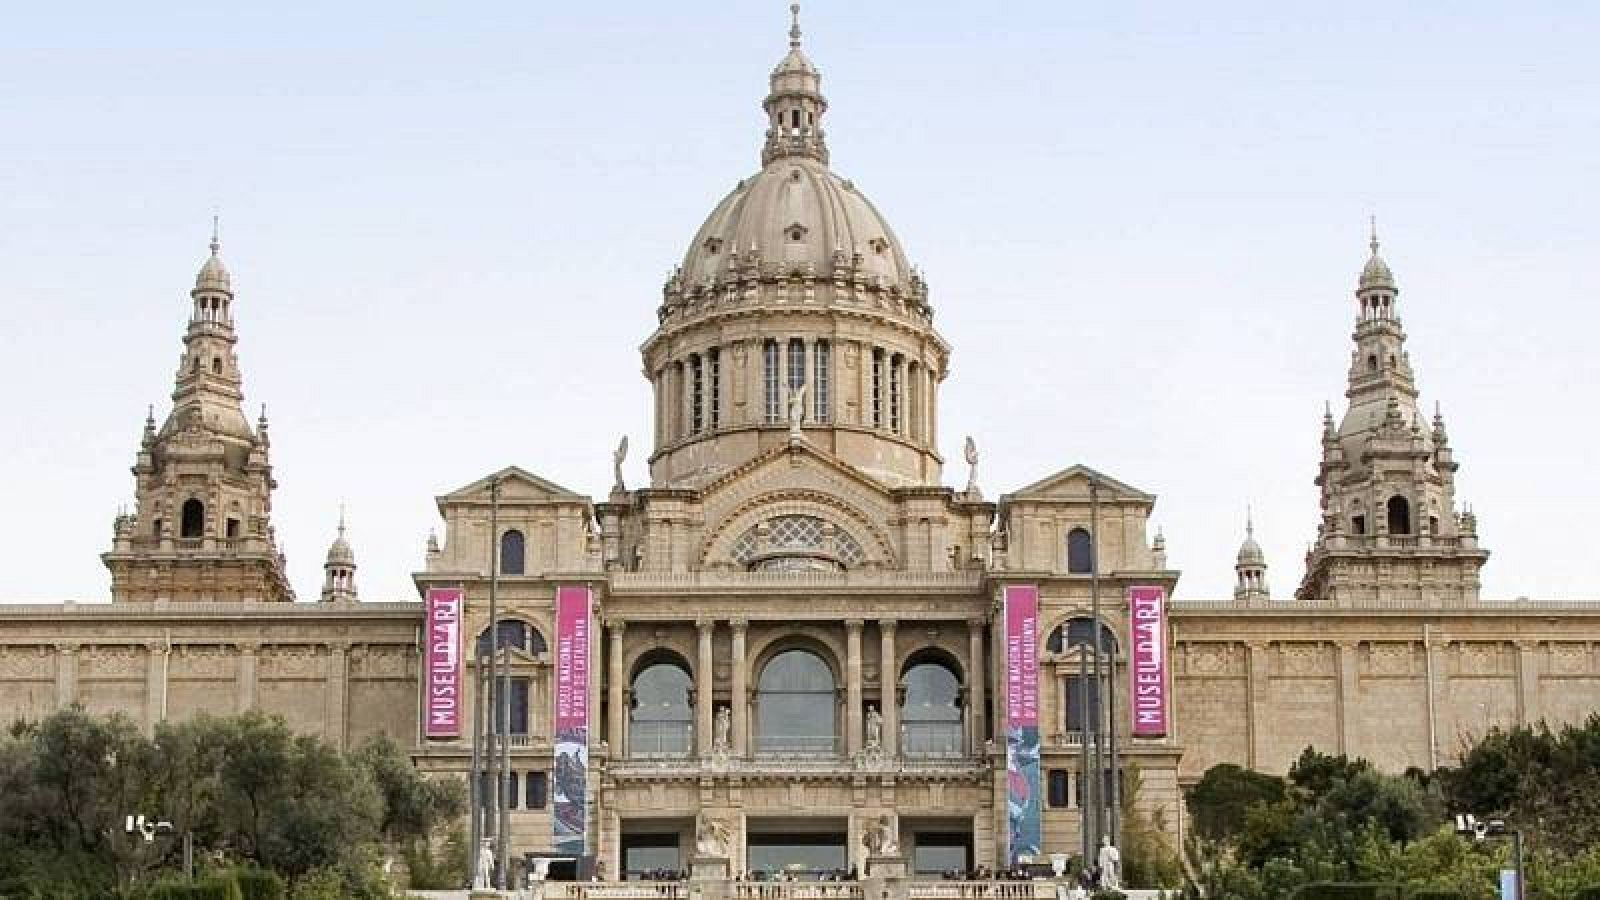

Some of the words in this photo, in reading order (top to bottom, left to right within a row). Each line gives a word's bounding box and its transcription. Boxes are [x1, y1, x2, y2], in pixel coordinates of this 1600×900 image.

[432, 600, 458, 653] D'ART
[573, 619, 585, 671] CATALUNYA
[1023, 617, 1035, 671] CATALUNYA
[1136, 598, 1162, 653] D'ART
[559, 636, 571, 682] NACIONAL
[573, 675, 585, 686] DE
[1009, 636, 1021, 682] NACIONAL
[1023, 674, 1035, 685] DE
[432, 663, 455, 725] MUSEU
[559, 686, 571, 717] MUSEU
[573, 690, 585, 717] D'ART
[1009, 686, 1021, 718] MUSEU
[1023, 690, 1035, 719] D'ART
[1137, 662, 1161, 724] MUSEU
